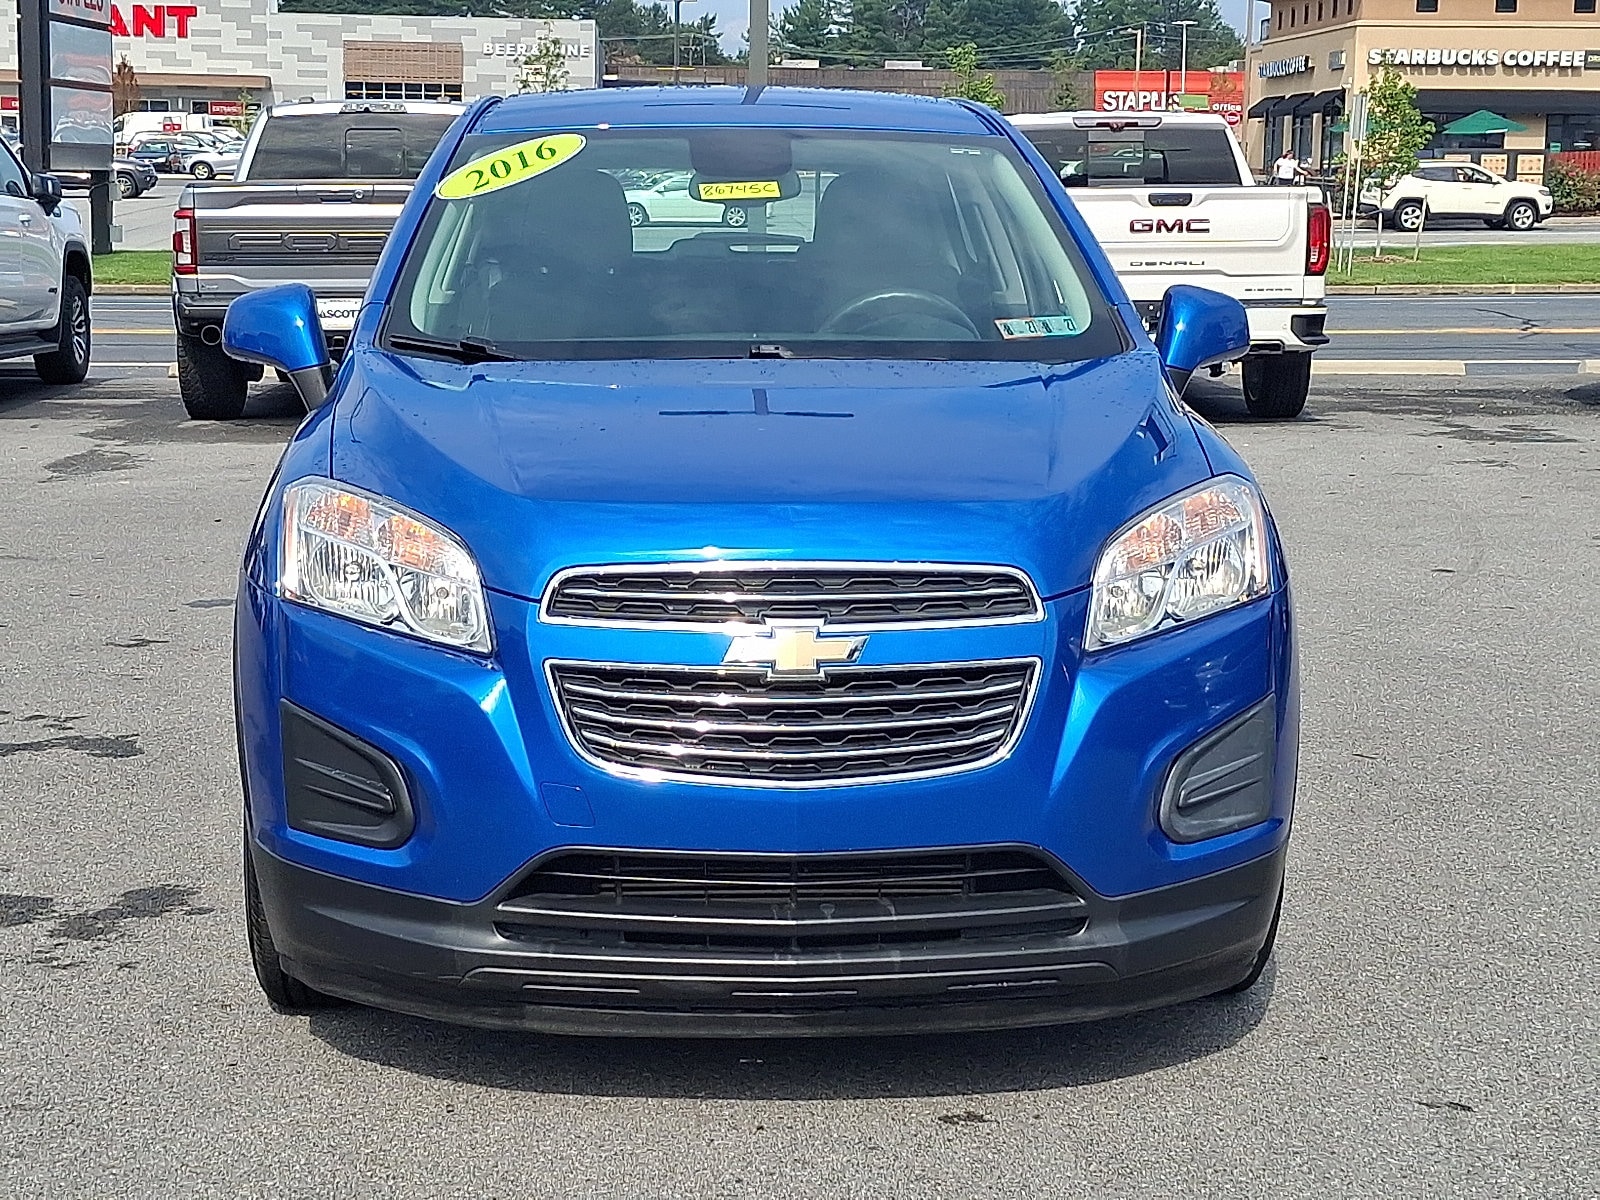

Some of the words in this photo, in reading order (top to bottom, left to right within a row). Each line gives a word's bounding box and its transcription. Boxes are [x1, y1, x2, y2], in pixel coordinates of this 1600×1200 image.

[111, 5, 197, 38] ANT
[483, 43, 527, 56] BEER
[1367, 49, 1499, 66] STARBUCKS
[1503, 49, 1585, 67] COFFEE
[465, 140, 557, 191] 2016
[1129, 218, 1211, 234] GMC
